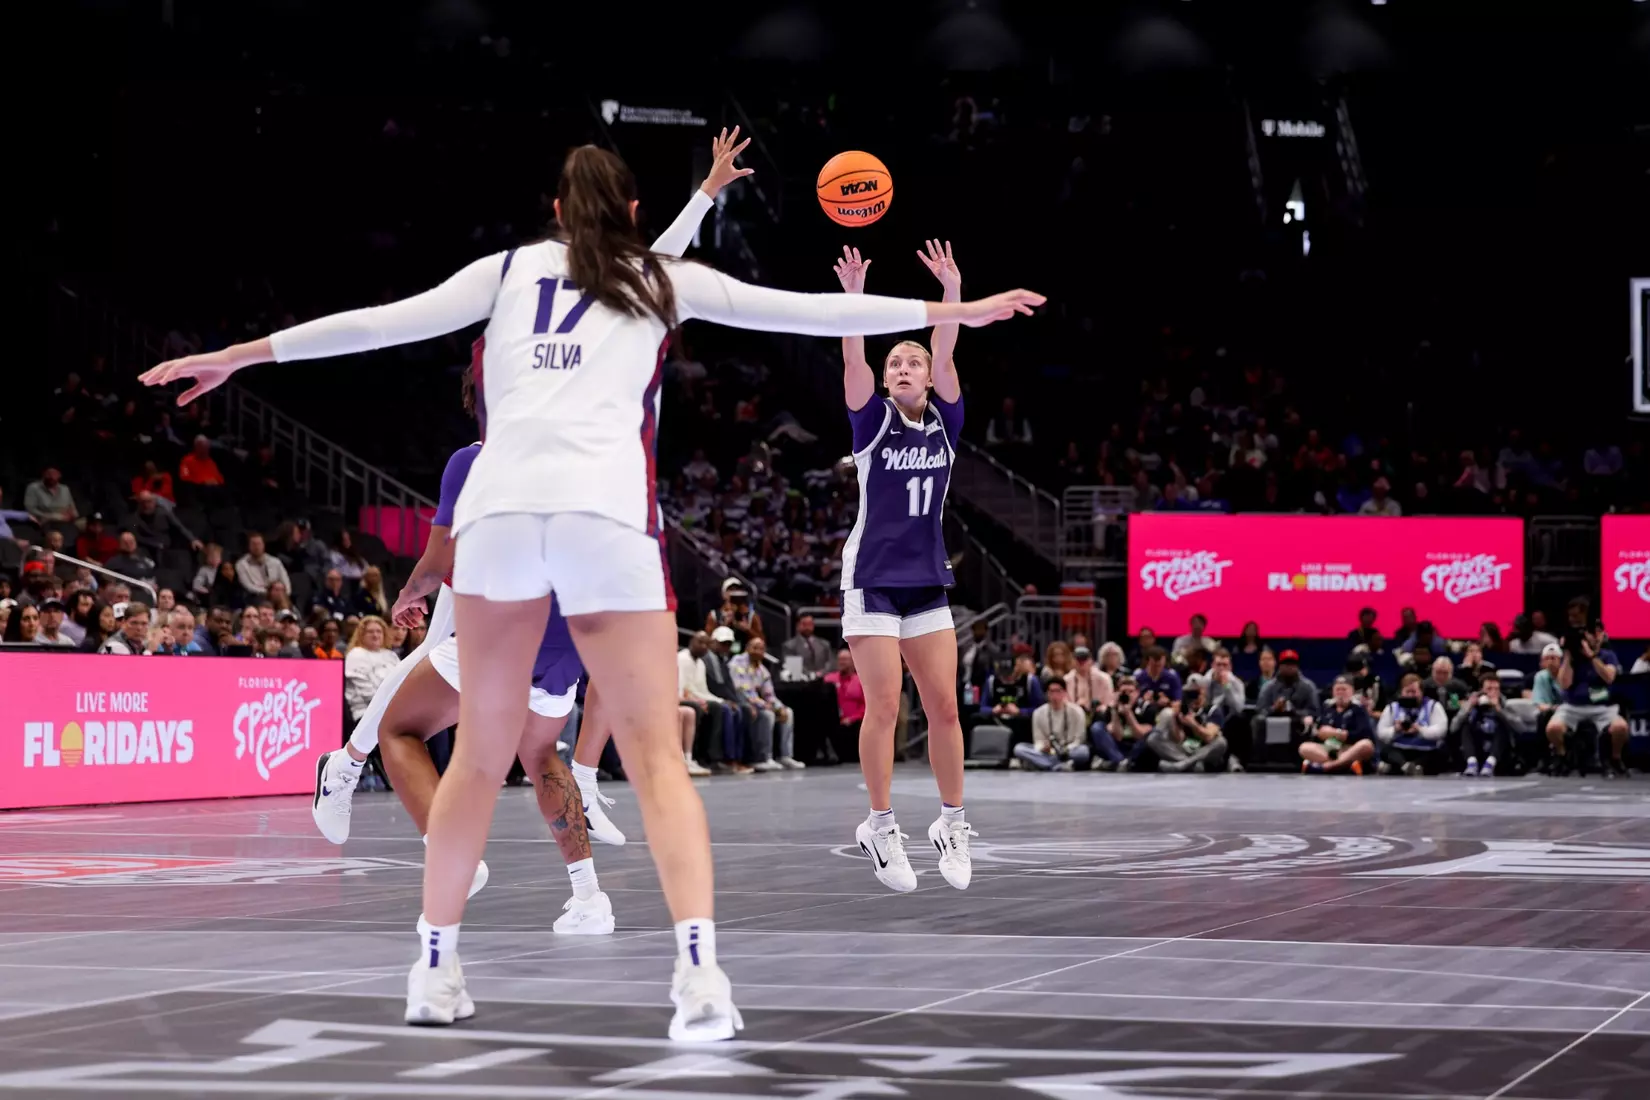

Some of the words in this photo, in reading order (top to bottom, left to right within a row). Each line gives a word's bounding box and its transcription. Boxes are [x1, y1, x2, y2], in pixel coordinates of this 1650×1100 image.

[841, 180, 877, 196] NCAA
[837, 200, 885, 218] Wilson
[533, 277, 597, 334] 17
[532, 342, 582, 370] SILVA
[906, 476, 934, 517] 11
[1267, 572, 1387, 592] FLORIDAYS
[238, 677, 282, 689] FLORIDA'S
[76, 692, 106, 713] LIVE
[110, 692, 149, 713] MORE
[233, 678, 308, 760] SPORTS
[23, 720, 194, 768] FLORIDAYS
[255, 698, 321, 781] COAST
